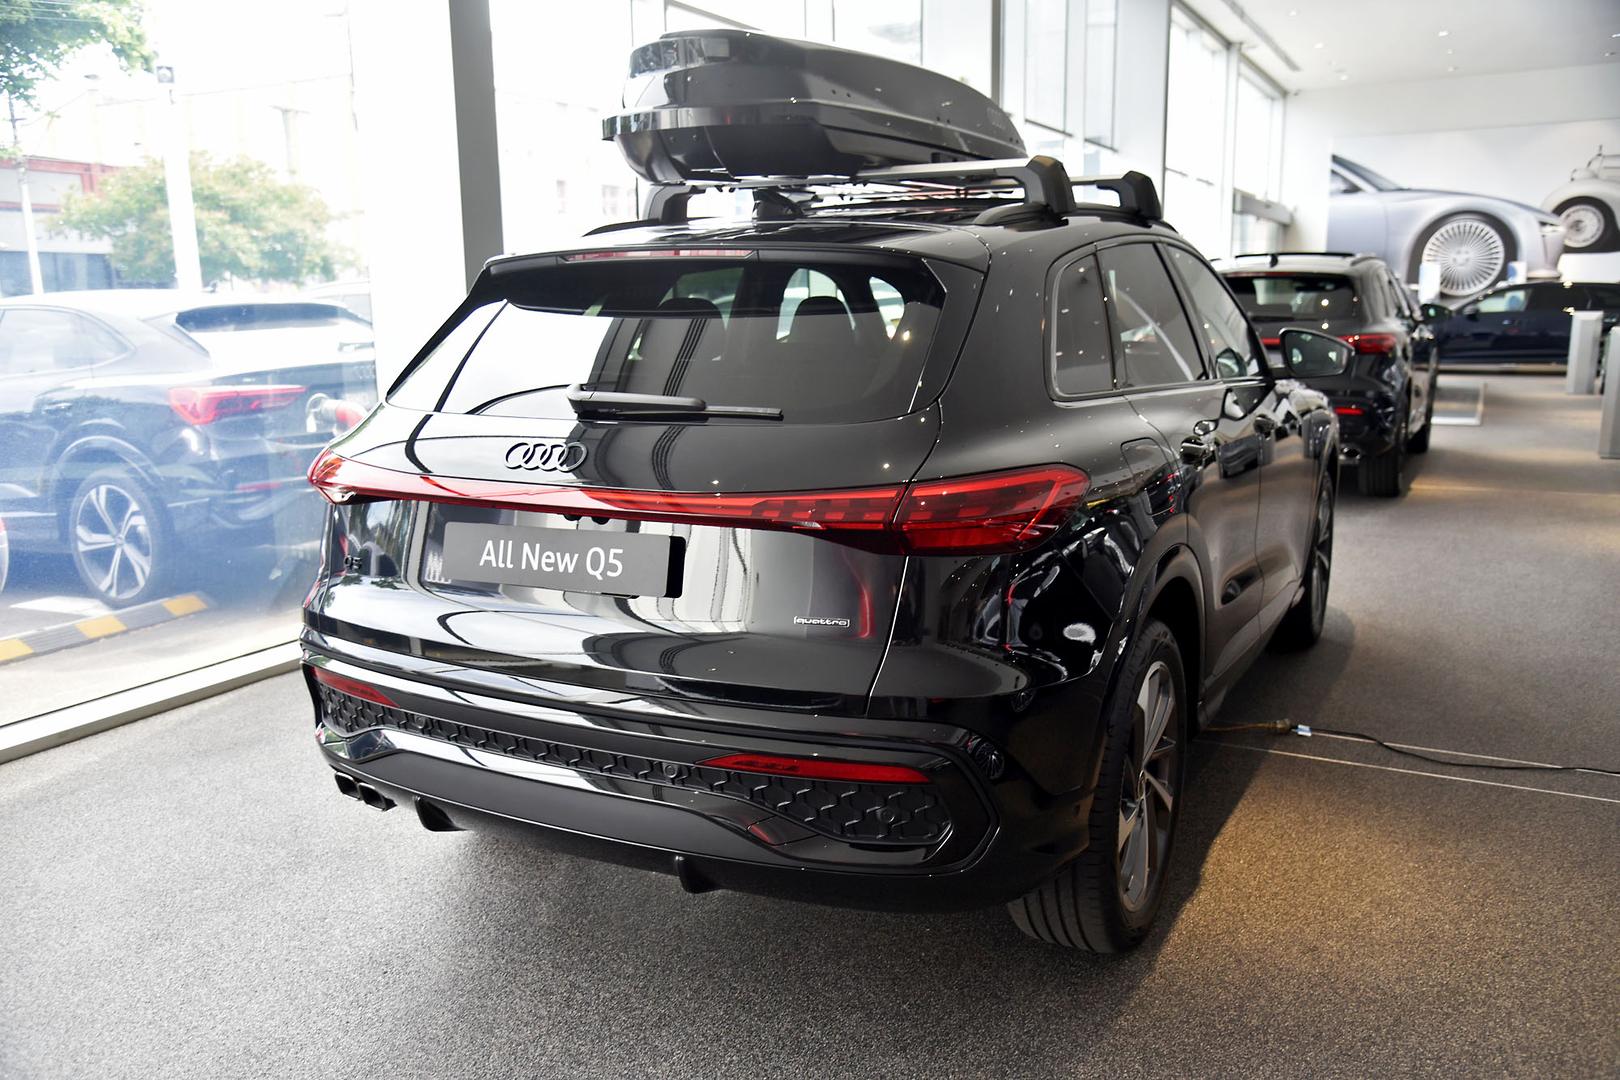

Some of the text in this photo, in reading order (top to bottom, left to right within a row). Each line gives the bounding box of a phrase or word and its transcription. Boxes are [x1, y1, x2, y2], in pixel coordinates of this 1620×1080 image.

[479, 539, 624, 581] All New Q5
[795, 616, 848, 627] quattro
